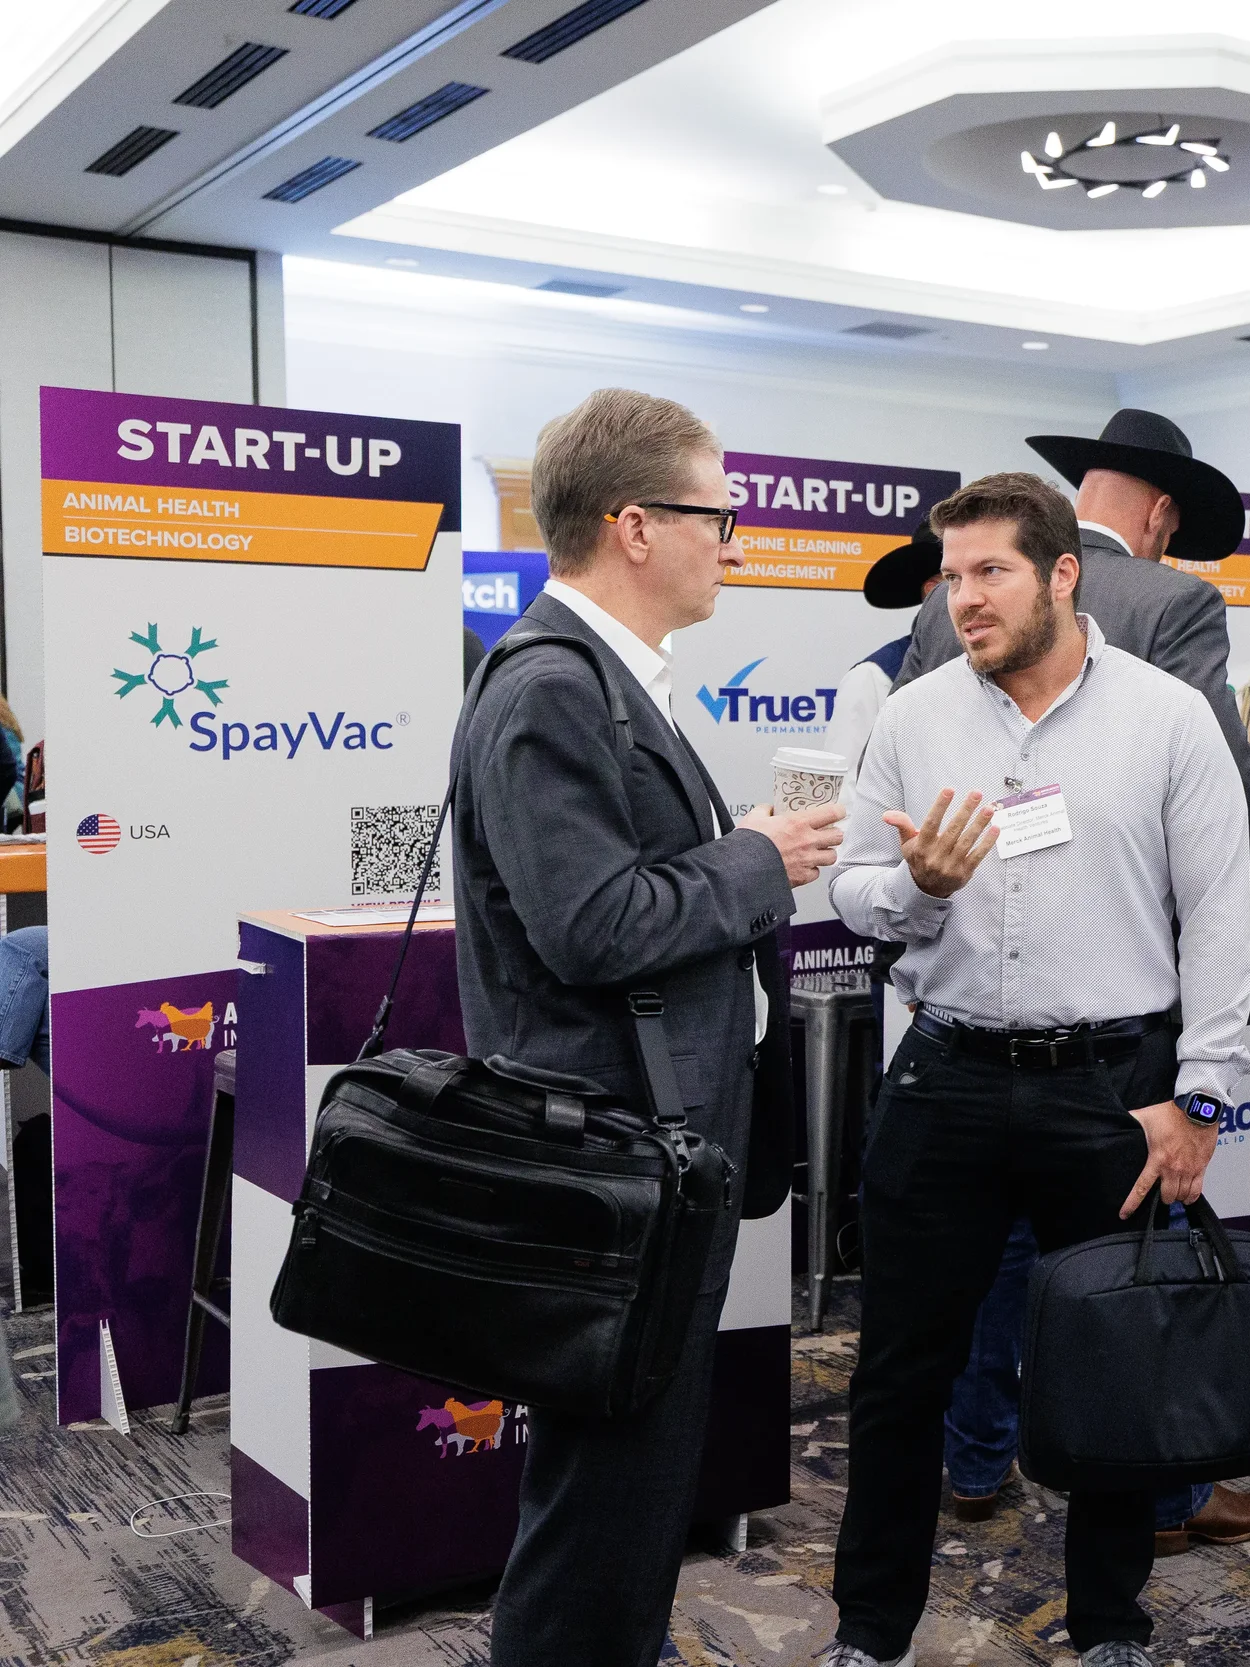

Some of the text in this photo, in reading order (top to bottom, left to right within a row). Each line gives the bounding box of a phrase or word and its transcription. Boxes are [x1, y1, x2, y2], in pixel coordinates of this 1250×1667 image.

[117, 419, 402, 478] START-UP
[728, 471, 920, 518] START-UP
[63, 492, 240, 518] ANIMAL HEALTH
[65, 526, 253, 551] BIOTECHNOLOGY
[789, 538, 862, 555] LEARNING
[730, 563, 837, 580] MANAGEMENT
[756, 725, 827, 734] PERMANENT
[1007, 803, 1048, 818] Rodrigo Souza
[130, 824, 171, 840] USA
[1005, 827, 1062, 846] Merck Animal Health
[792, 945, 874, 971] ANIMALAG
[1234, 1135, 1245, 1143] ID
